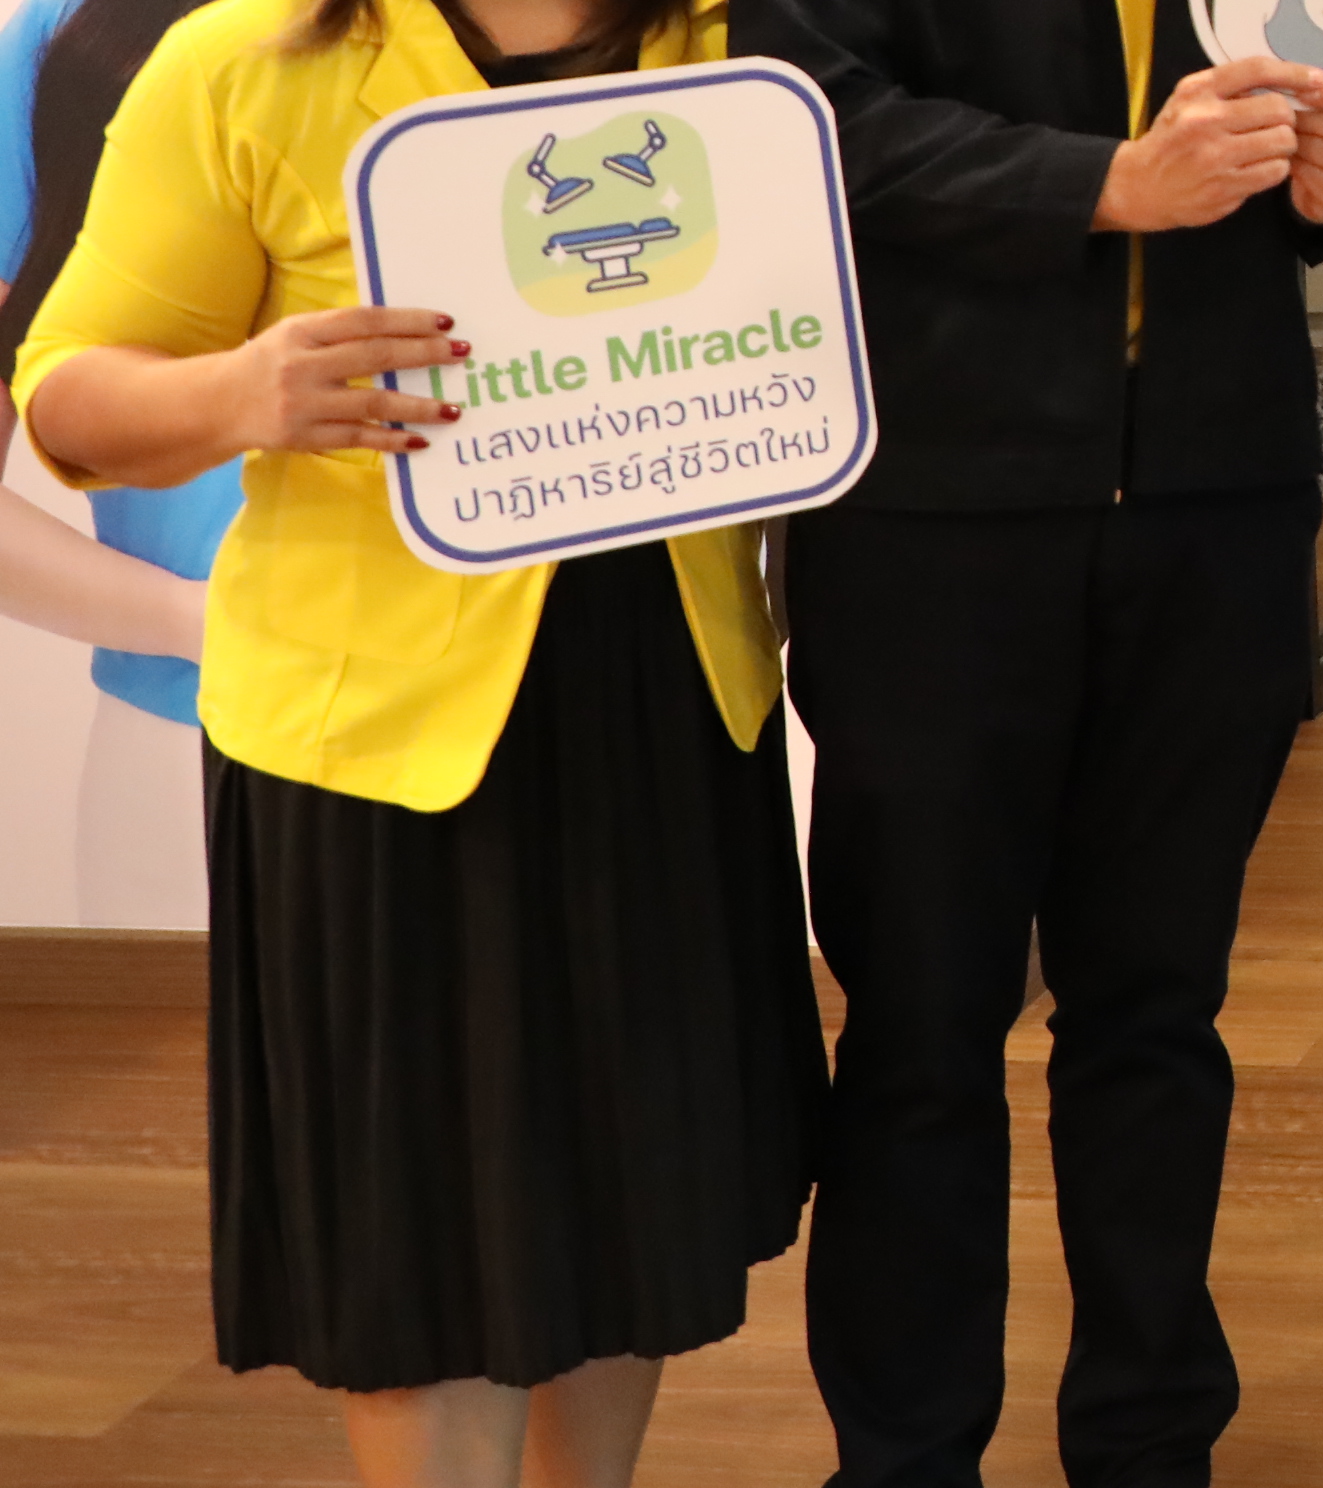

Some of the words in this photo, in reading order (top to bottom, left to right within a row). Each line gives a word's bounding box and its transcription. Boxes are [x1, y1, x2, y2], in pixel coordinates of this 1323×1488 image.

[428, 349, 588, 410] Little
[606, 308, 823, 384] Miracle
[454, 374, 817, 466] แสงแห่งความหวัง
[454, 415, 832, 523] ปาฏิหาริย์สู่ชีวิตใหม่
